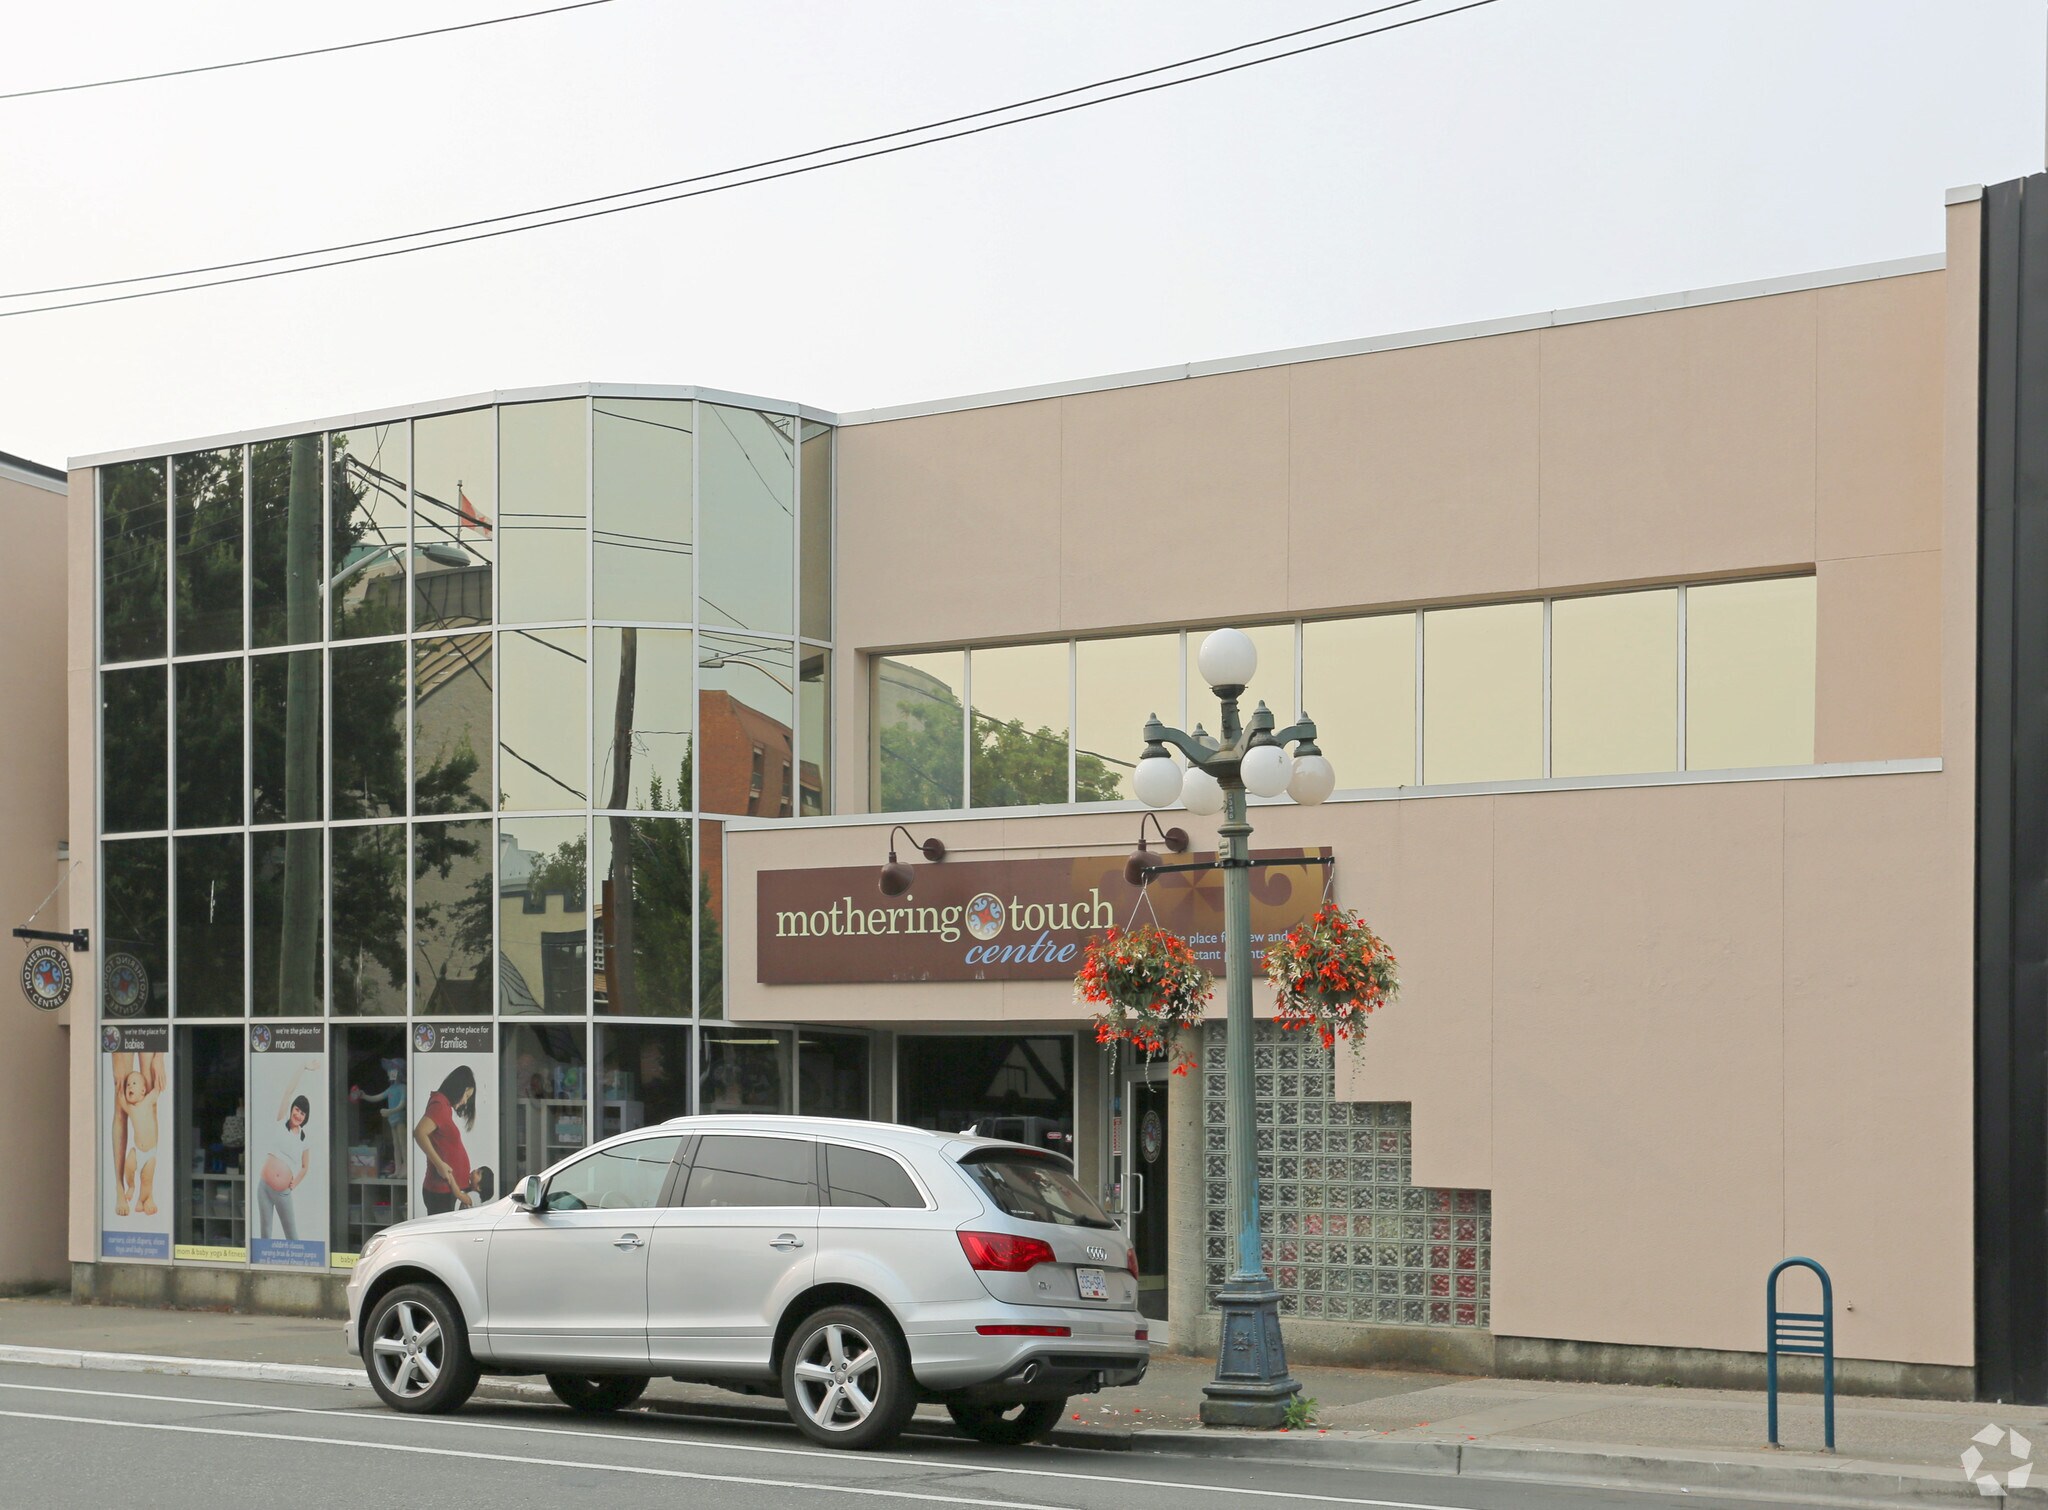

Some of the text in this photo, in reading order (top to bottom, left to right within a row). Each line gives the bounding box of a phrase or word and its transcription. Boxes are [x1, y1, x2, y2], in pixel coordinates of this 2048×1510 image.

[775, 888, 1114, 943] mothering touch
[1189, 932, 1218, 947] place
[1267, 930, 1288, 942] and
[964, 930, 1078, 965] centre
[1193, 950, 1221, 960] ctant
[24, 948, 71, 992] MOTHERING TOUCH
[32, 994, 63, 1008] CENTRE
[138, 1028, 146, 1036] the
[146, 1028, 159, 1037] place
[159, 1027, 167, 1035] for
[290, 1027, 299, 1035] the
[299, 1027, 312, 1036] place
[312, 1026, 321, 1034] for
[440, 1026, 489, 1035] we're the place for
[124, 1038, 145, 1050] babies
[275, 1040, 296, 1049] moms
[440, 1036, 468, 1049] families
[196, 1248, 208, 1257] baby
[209, 1250, 222, 1258] yoga
[340, 1256, 354, 1265] baby
